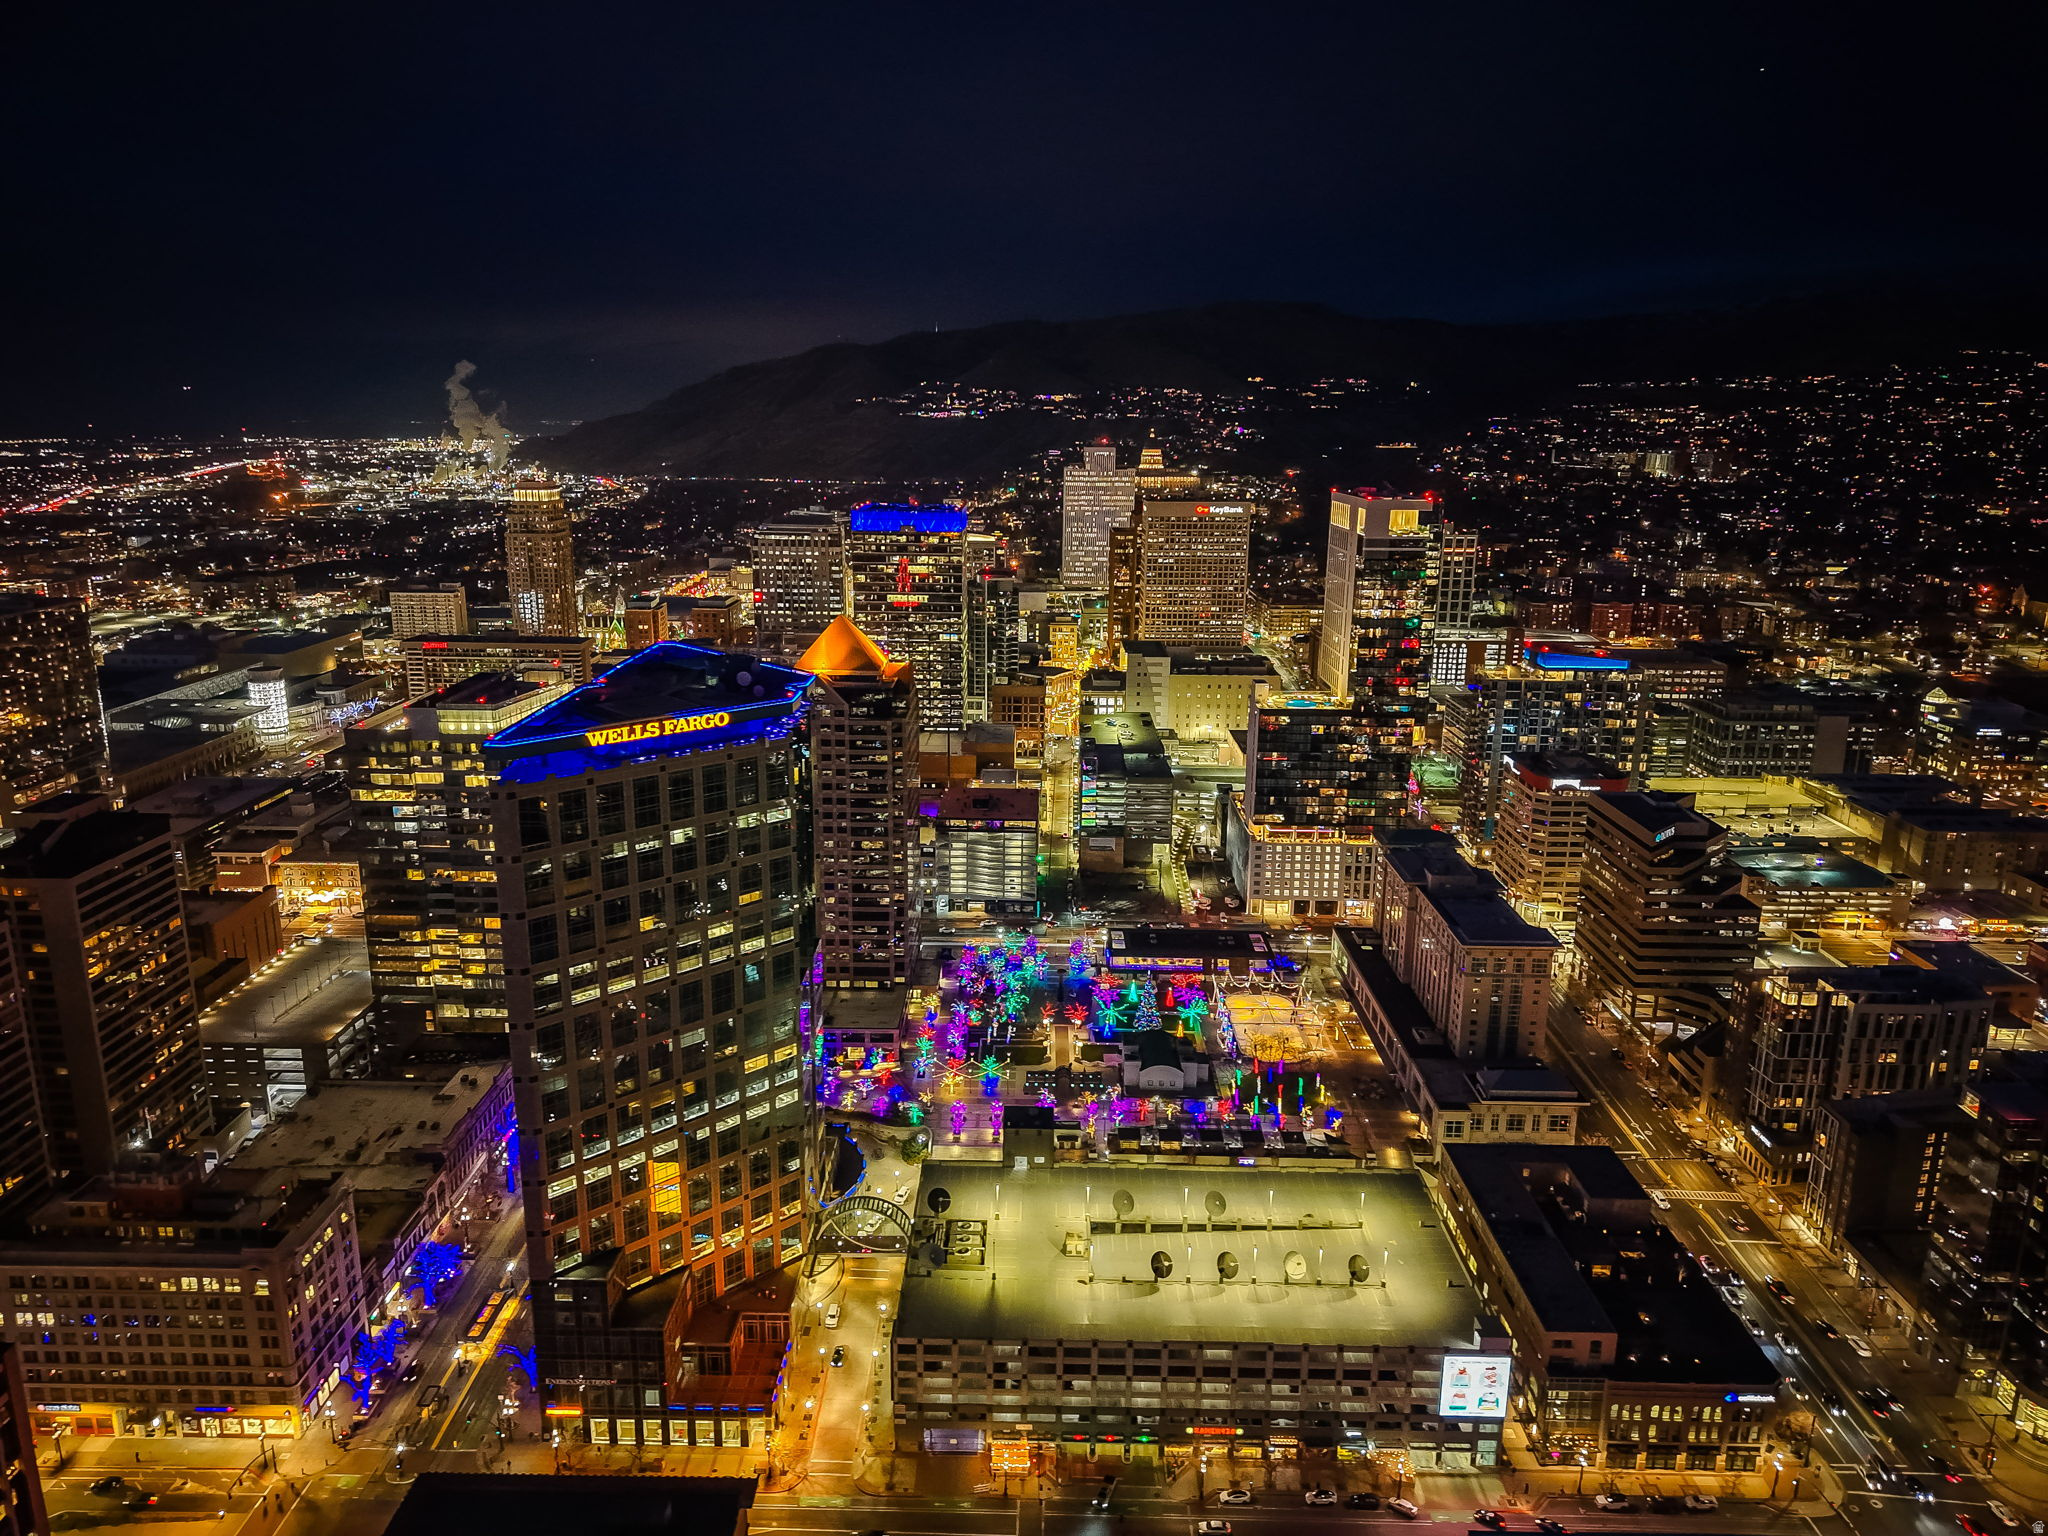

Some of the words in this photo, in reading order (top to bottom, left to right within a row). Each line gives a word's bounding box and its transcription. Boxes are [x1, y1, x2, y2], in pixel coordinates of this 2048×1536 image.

[1209, 505, 1244, 515] KeyBank
[585, 721, 660, 748] WELLS
[662, 711, 731, 736] FARGO
